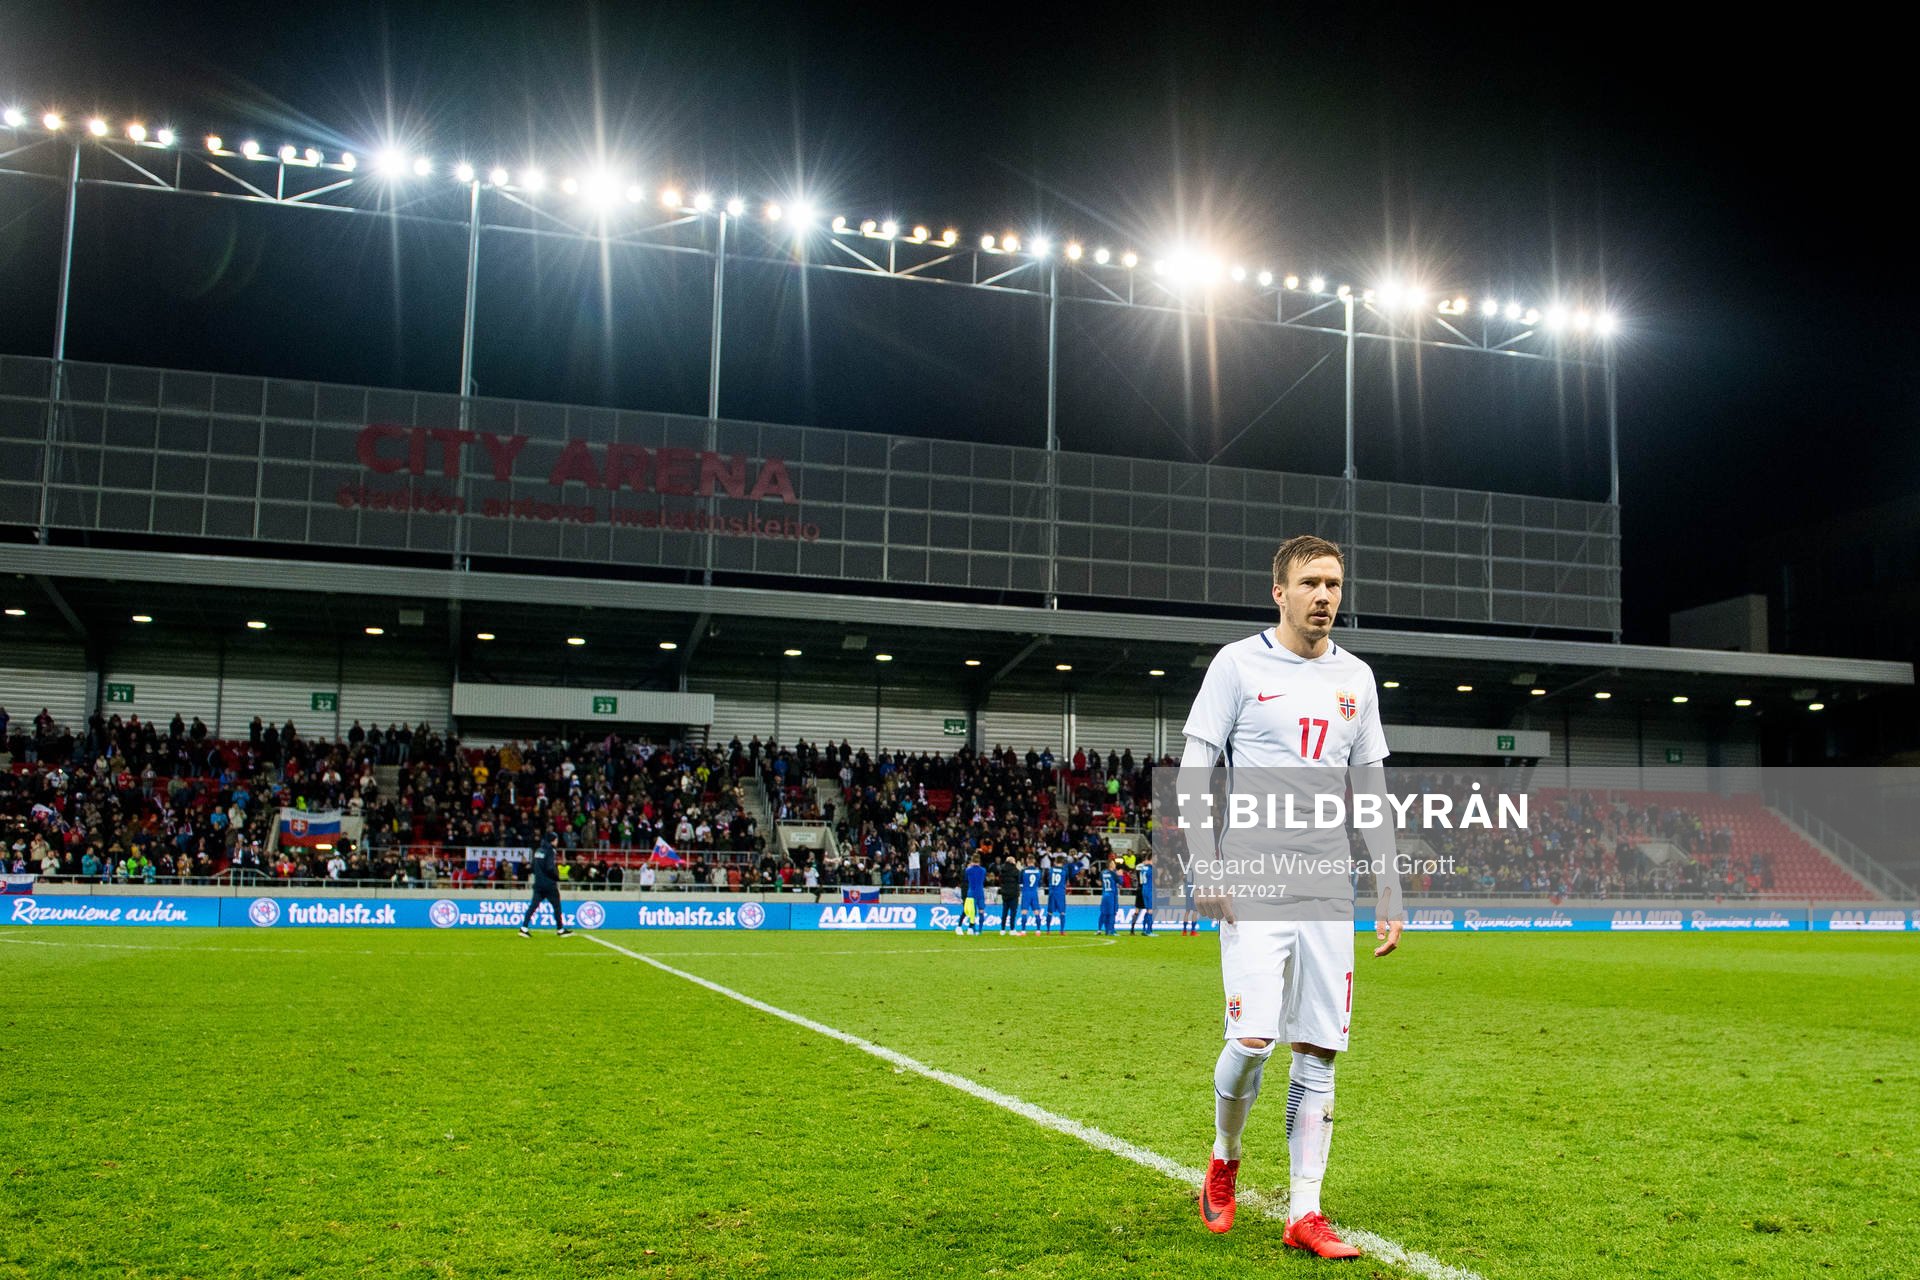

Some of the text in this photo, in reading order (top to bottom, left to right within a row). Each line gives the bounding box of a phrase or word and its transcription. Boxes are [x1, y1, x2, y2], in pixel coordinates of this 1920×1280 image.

[355, 423, 798, 504] CITY ARENA
[112, 690, 128, 701] 21
[1298, 717, 1329, 760] 17
[1029, 874, 1036, 887] 9
[12, 898, 121, 924] Rozumieme
[288, 902, 396, 924] futbalsfz.sk
[638, 906, 736, 926] futbalsfz.sk
[819, 906, 917, 924] AAA AUTO
[1412, 910, 1454, 925] AUTO
